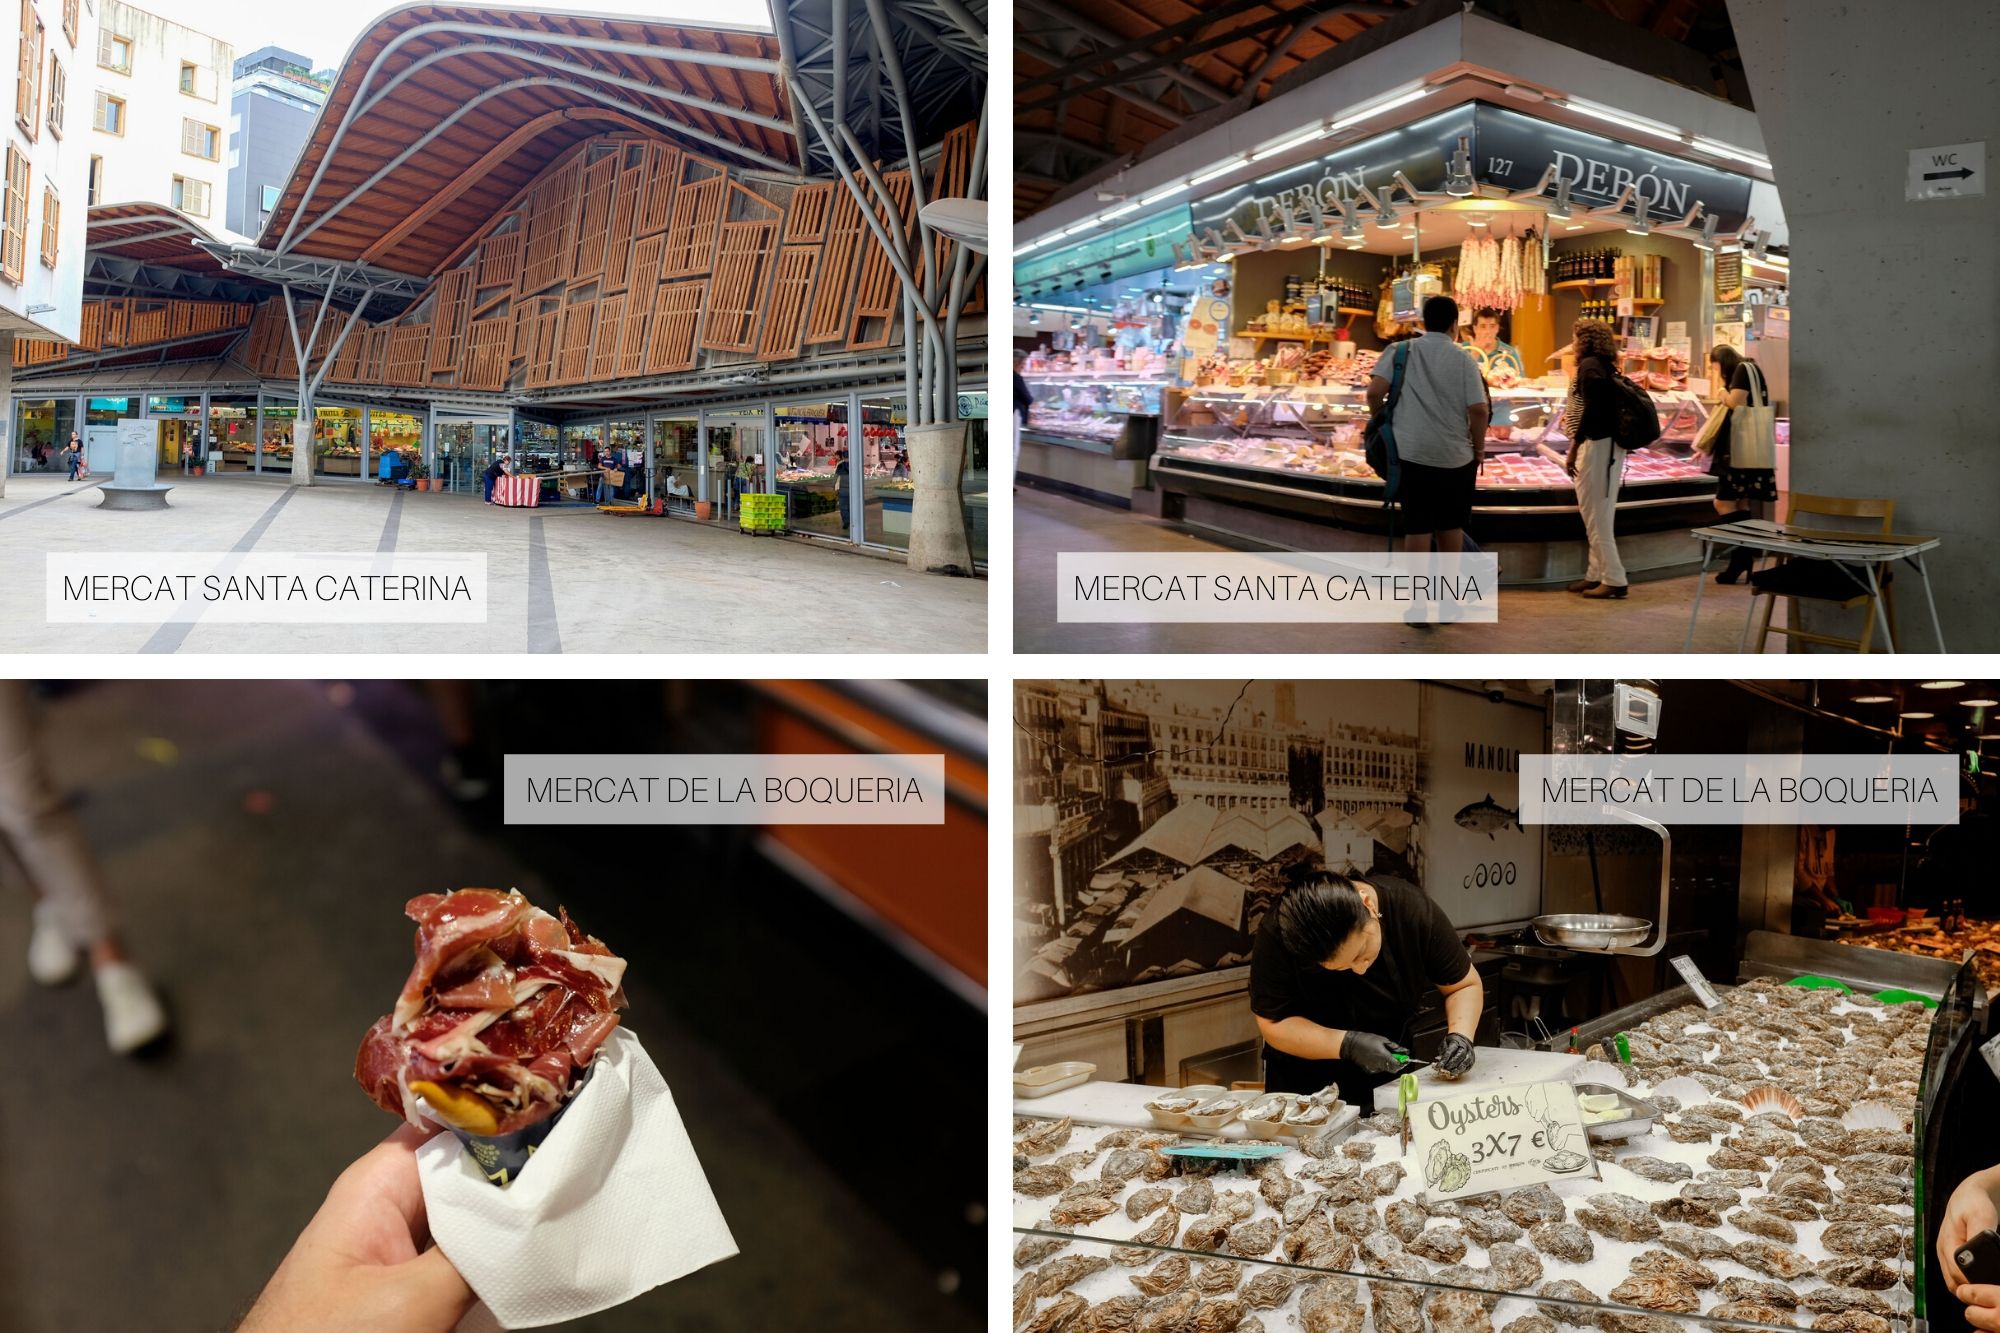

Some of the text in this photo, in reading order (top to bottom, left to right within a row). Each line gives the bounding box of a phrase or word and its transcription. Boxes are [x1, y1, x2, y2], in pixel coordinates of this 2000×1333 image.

[1487, 156, 1514, 177] 127
[1931, 152, 1958, 167] WC
[1549, 149, 1691, 214] DEBÓN
[1427, 1094, 1523, 1136] Oysters
[1530, 1129, 1547, 1148] €
